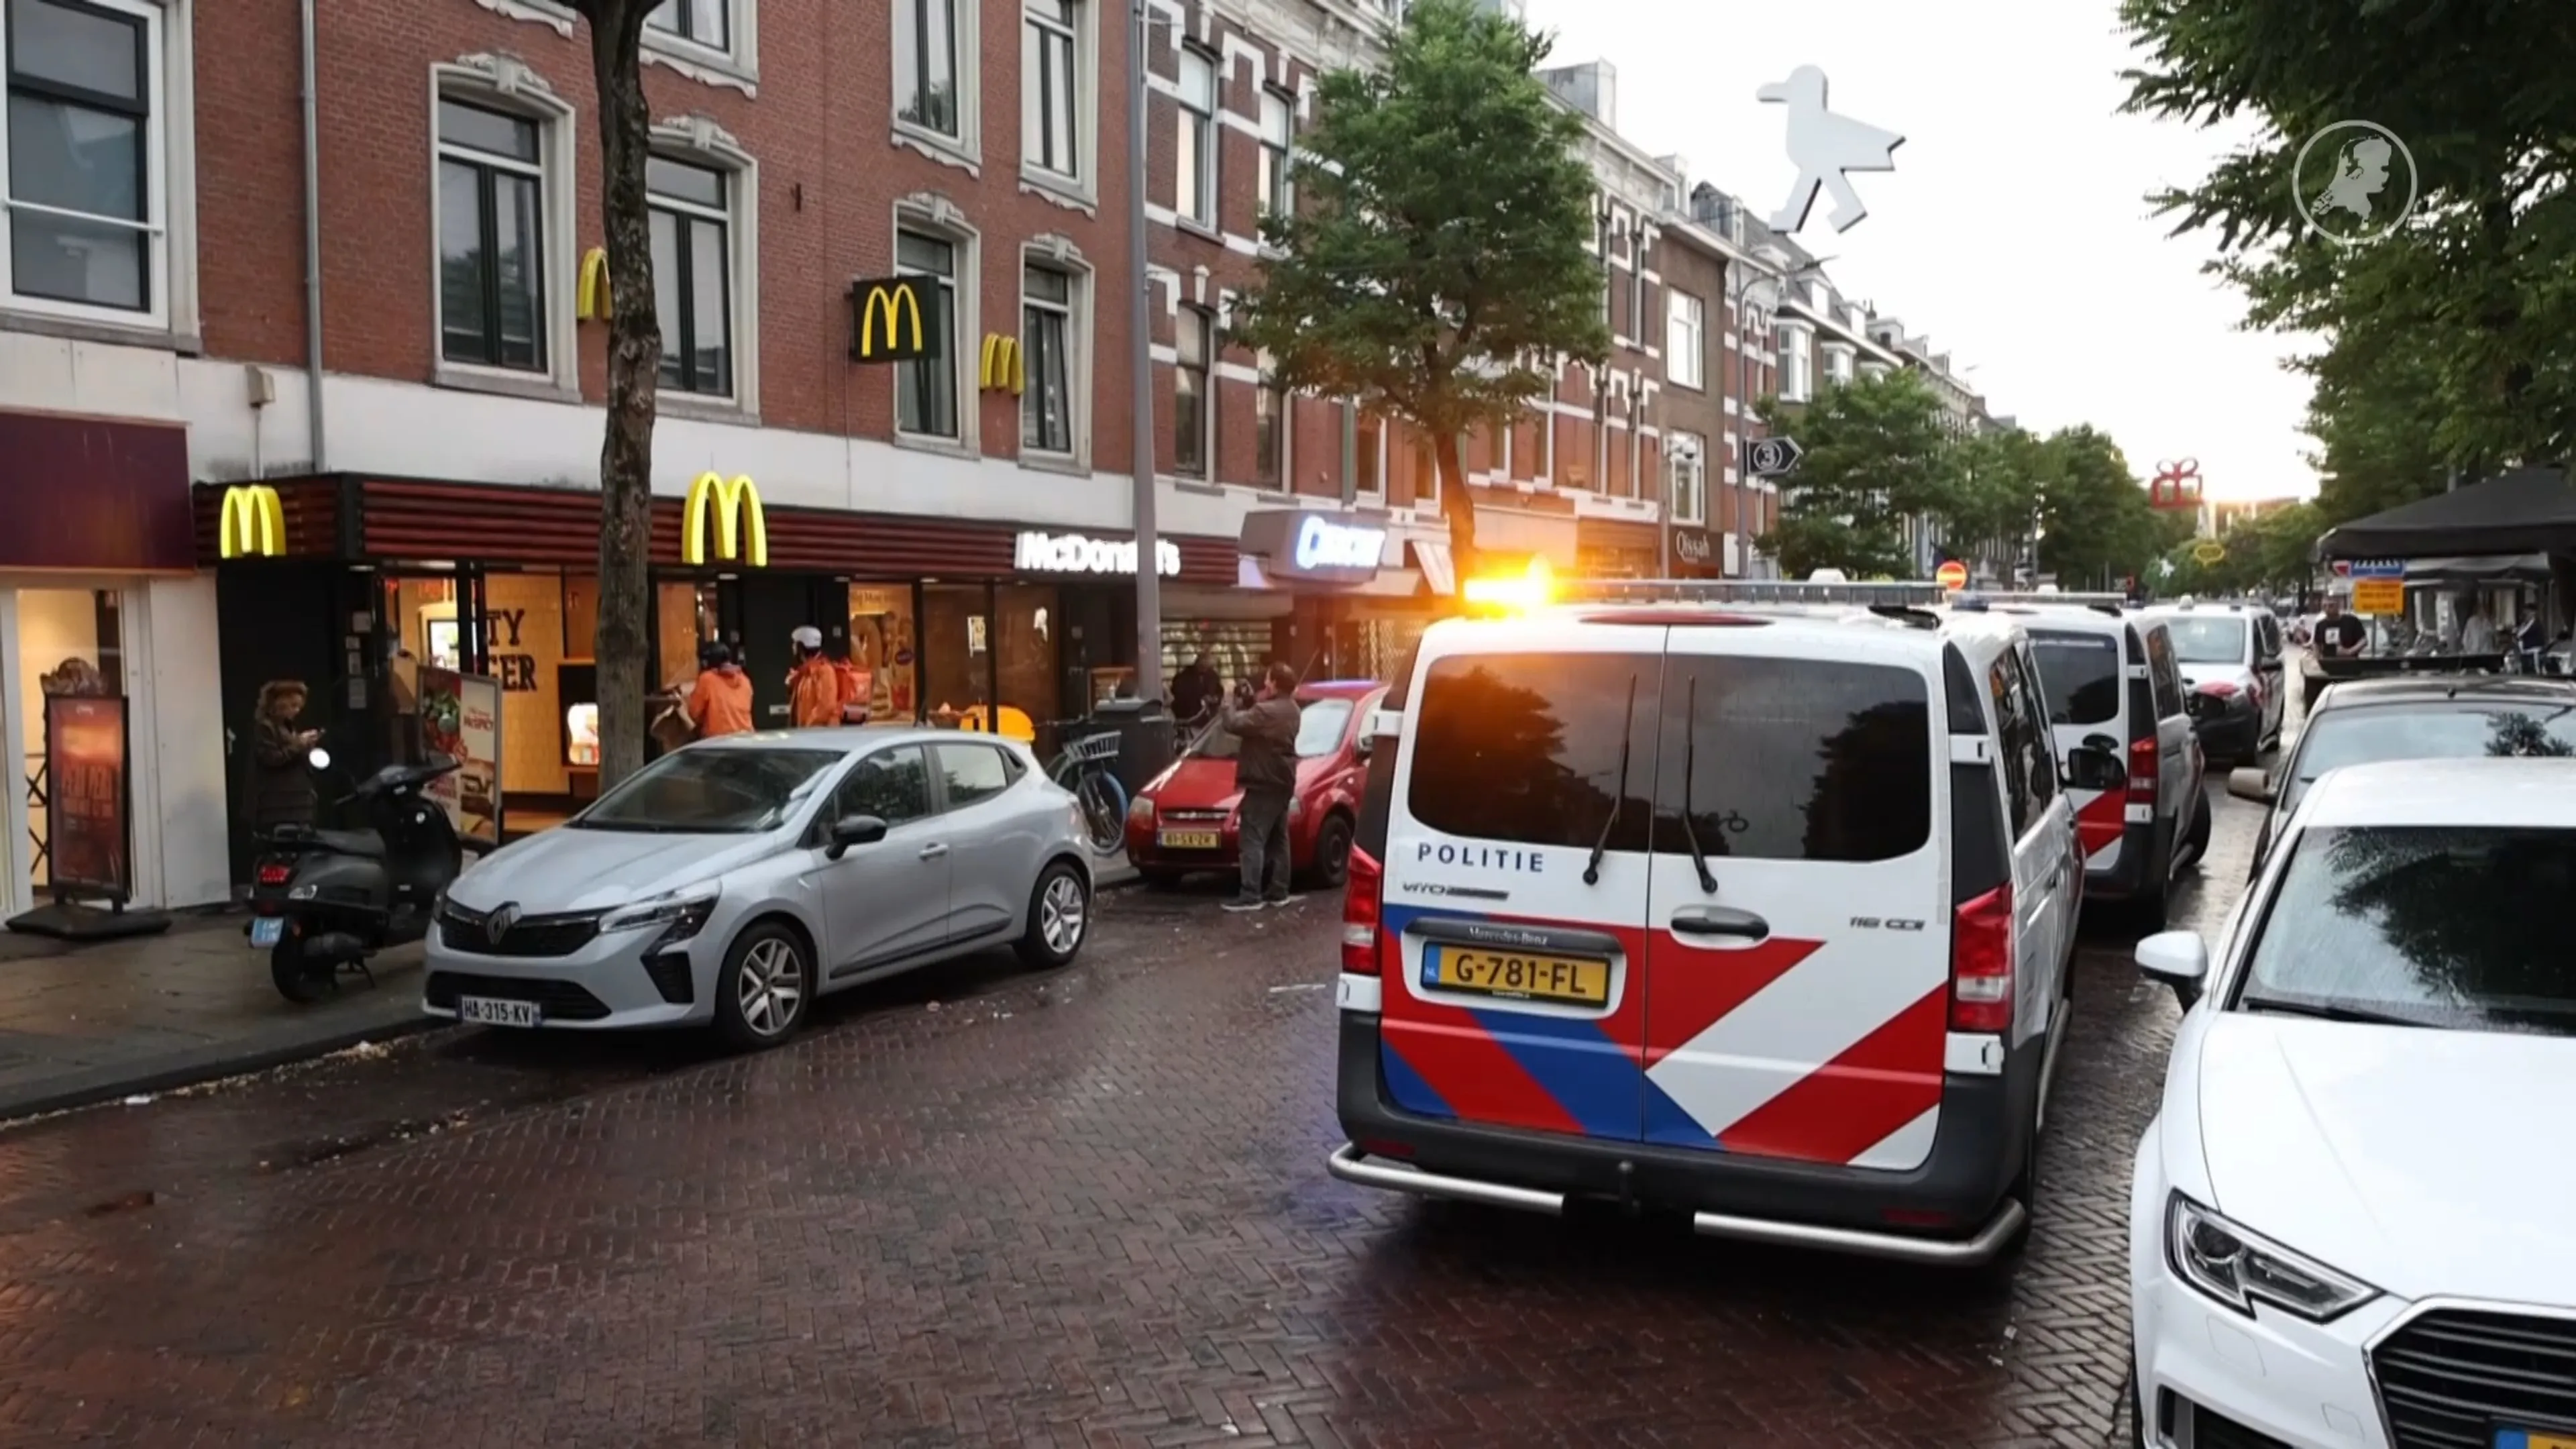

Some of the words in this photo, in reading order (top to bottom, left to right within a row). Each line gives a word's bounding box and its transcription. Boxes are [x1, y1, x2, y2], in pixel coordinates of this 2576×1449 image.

[1014, 531, 1181, 576] McDona's
[1417, 843, 1544, 872] POLITIE
[1468, 926, 1549, 946] Mercedes-Benz
[1456, 954, 1587, 994] G-781-FL
